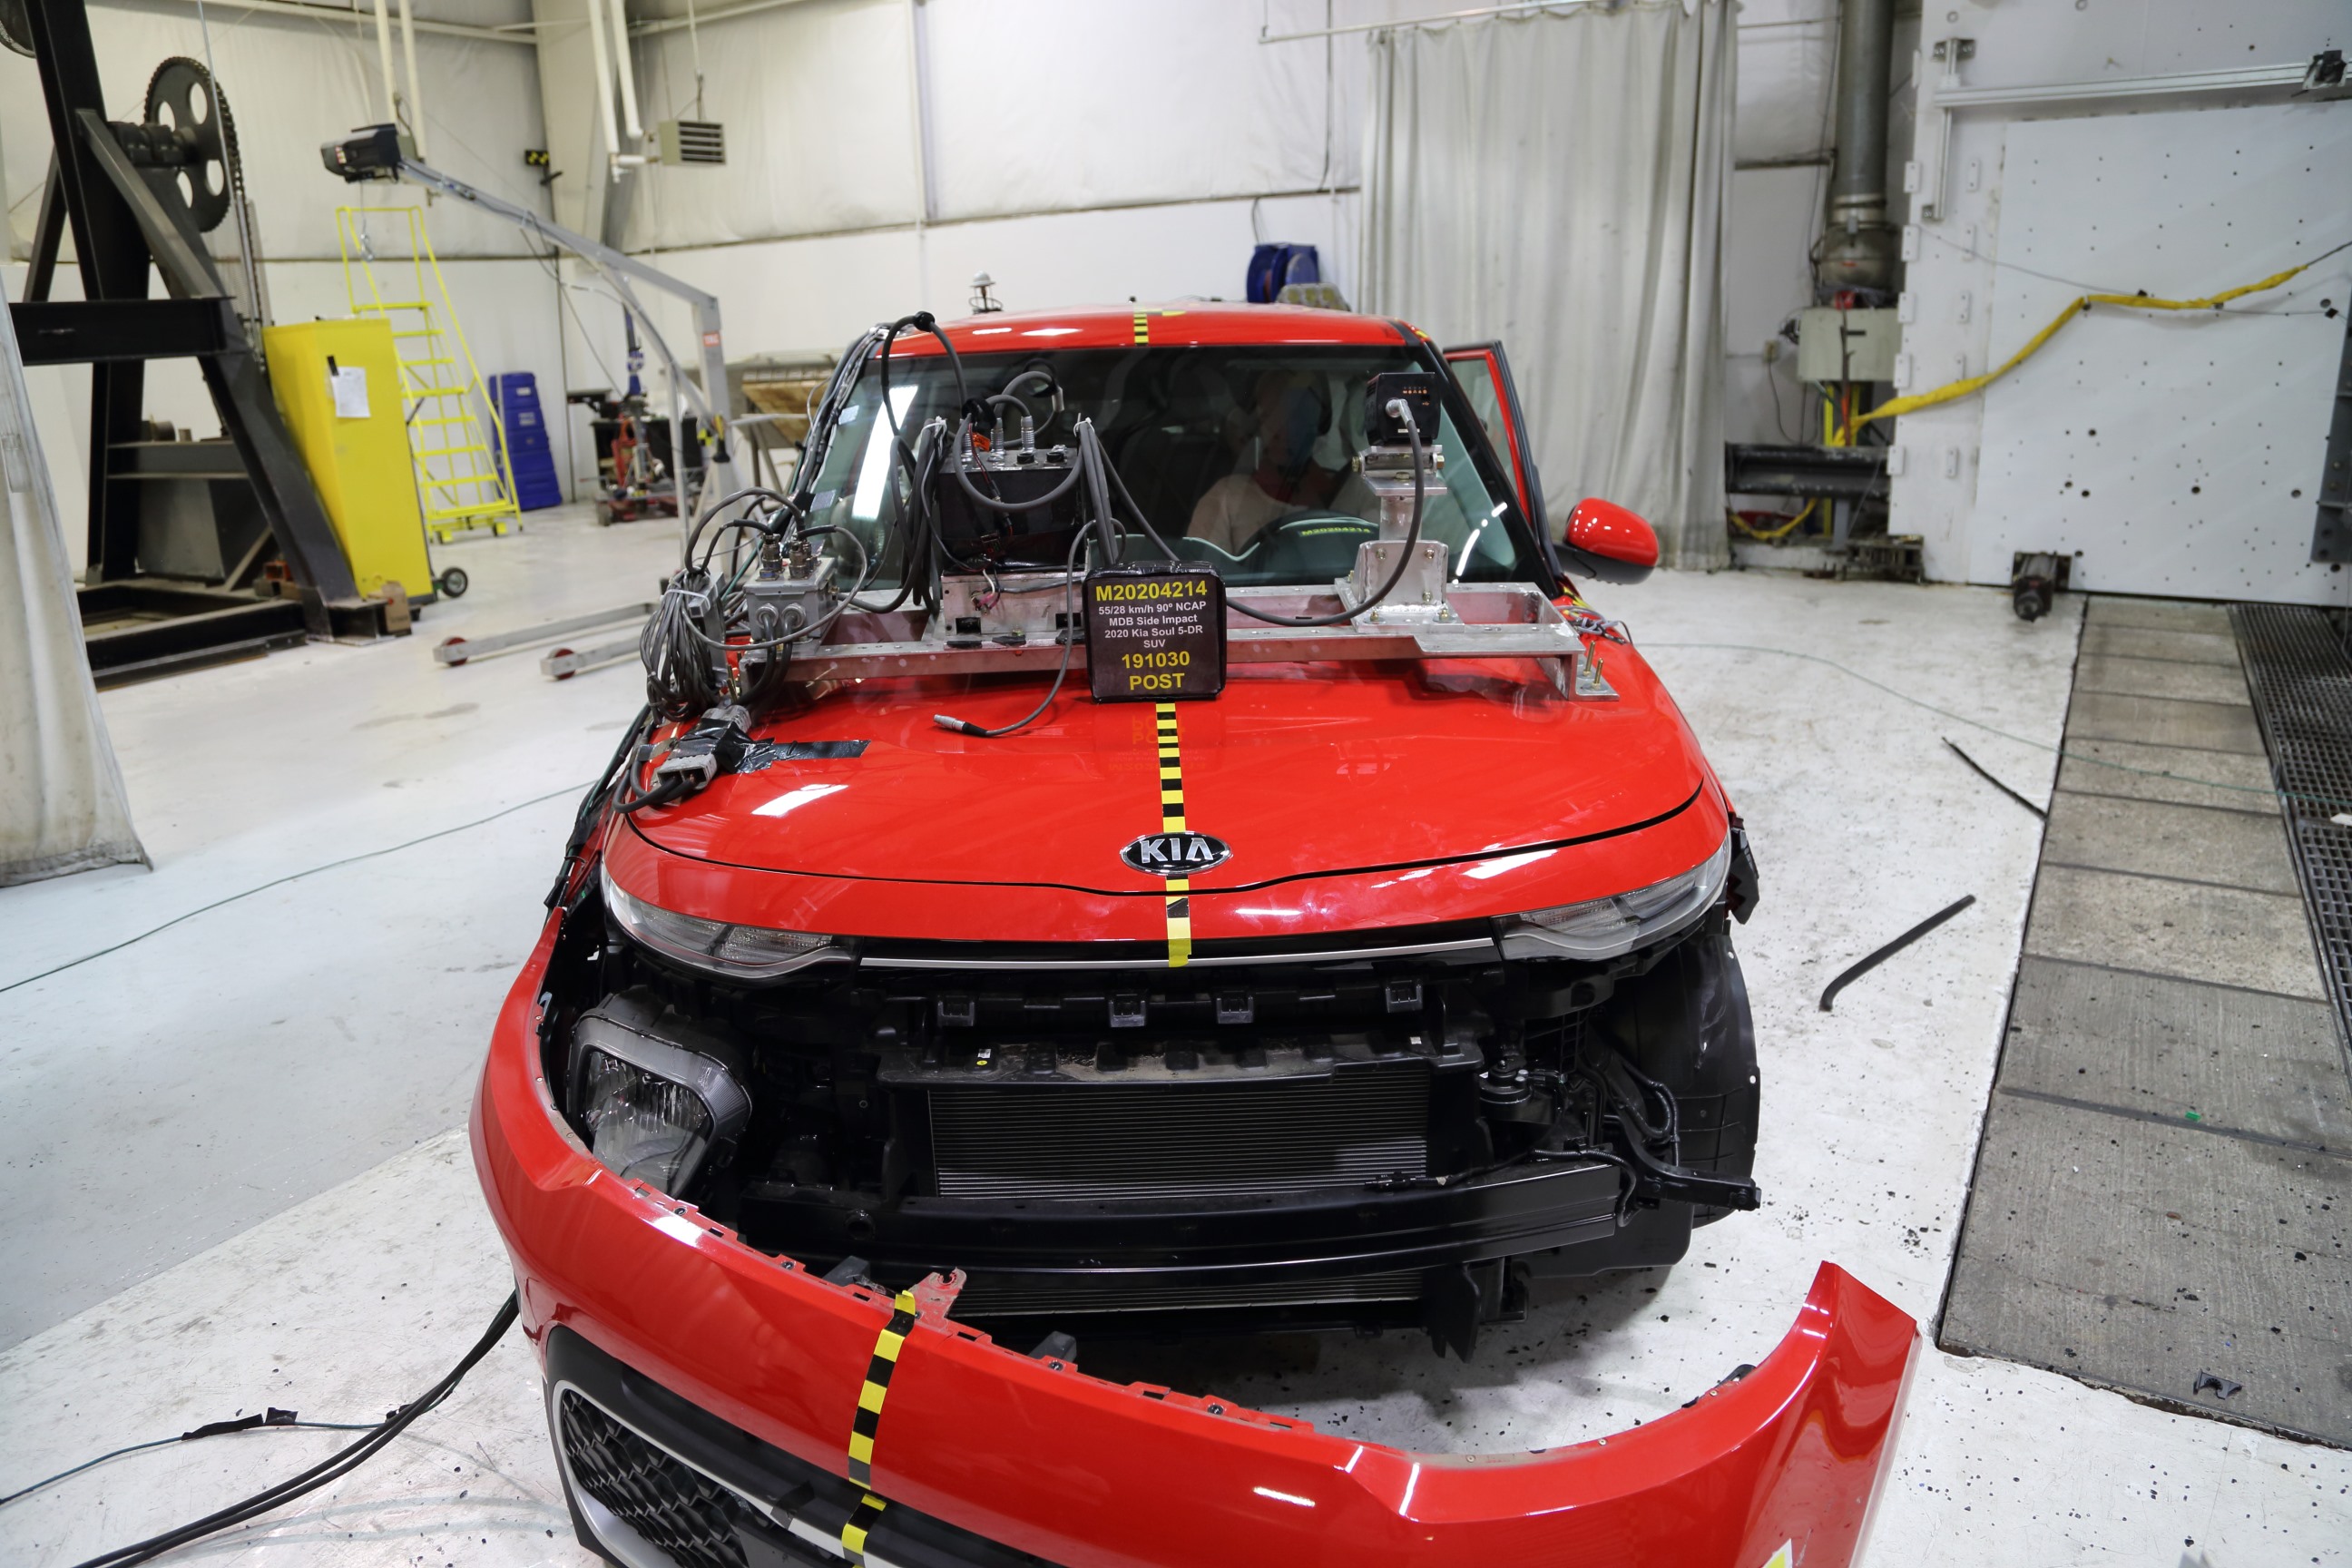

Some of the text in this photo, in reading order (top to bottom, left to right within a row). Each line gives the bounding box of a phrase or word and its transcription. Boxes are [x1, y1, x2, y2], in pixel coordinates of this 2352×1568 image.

[1095, 580, 1208, 602] M20204214
[1098, 605, 1126, 615] 55/28
[1128, 604, 1154, 614] km/h
[1175, 601, 1207, 612] NCAP
[1109, 613, 1198, 626] MDB Side Impact
[1104, 624, 1203, 639] 2020 Kia Soul 5-DR
[1143, 639, 1166, 648] SUV
[1122, 651, 1191, 669] 191030
[1129, 672, 1185, 691] POST
[1140, 838, 1214, 864] KIA
